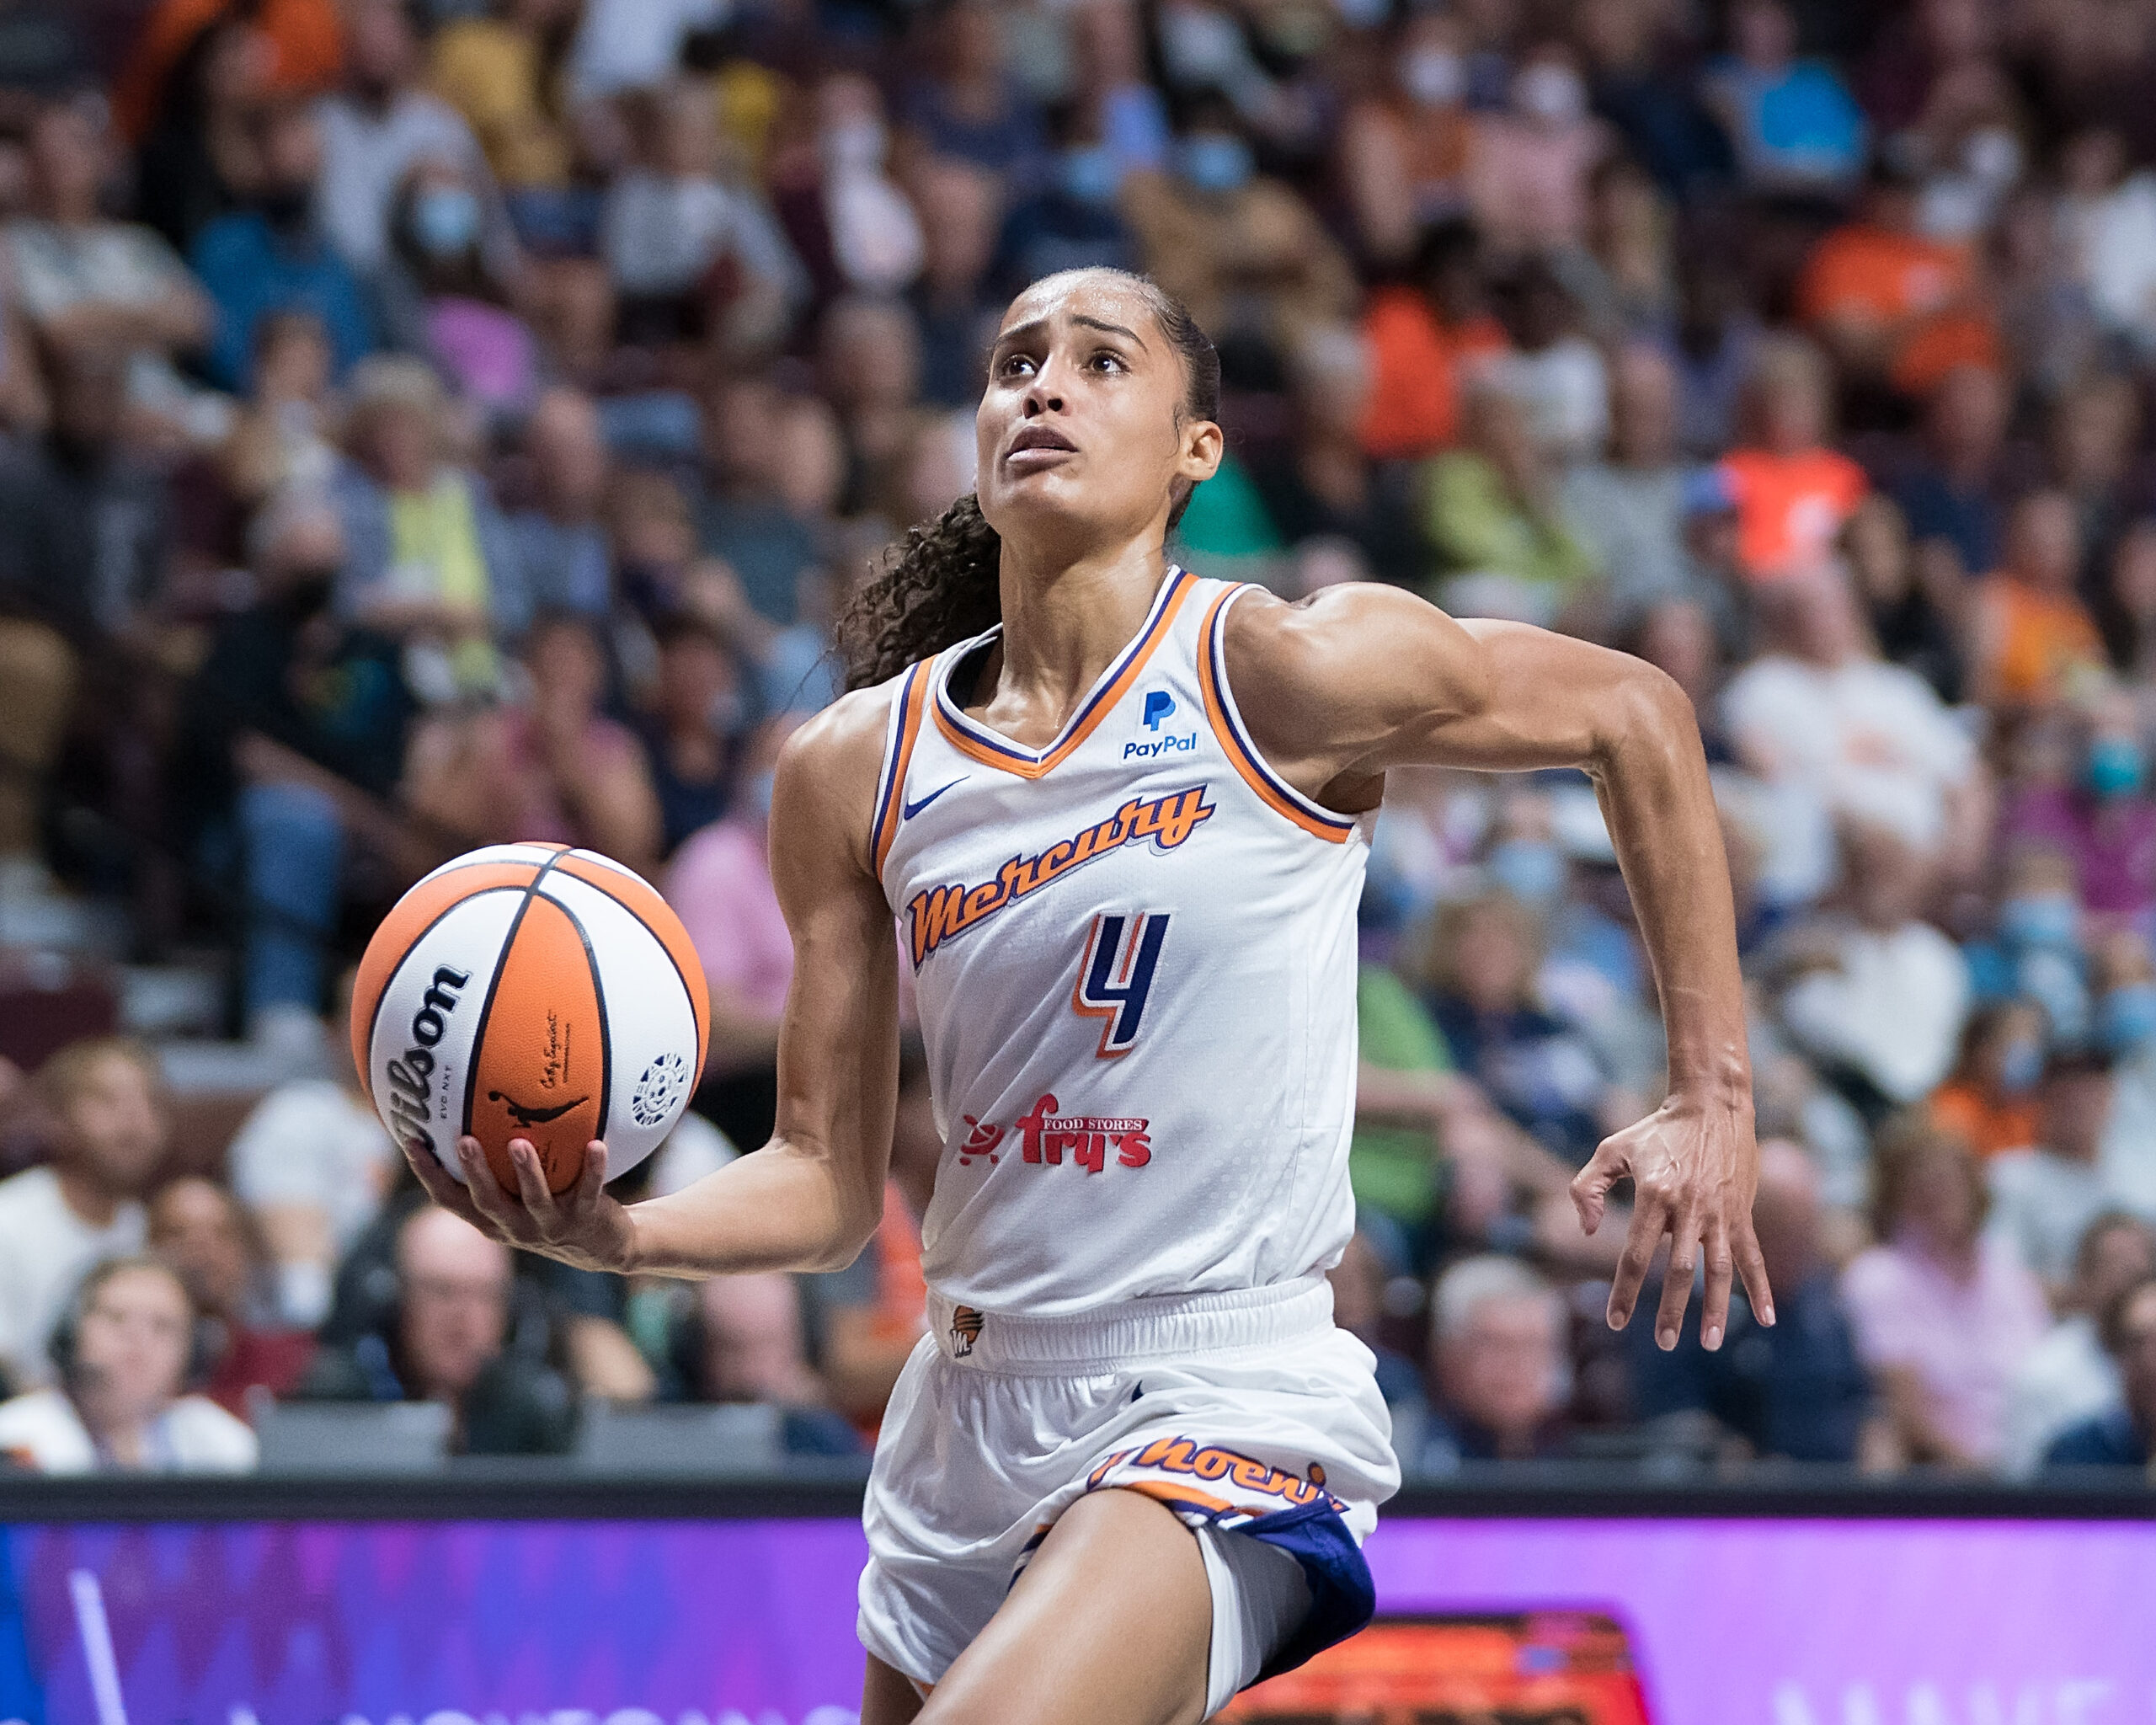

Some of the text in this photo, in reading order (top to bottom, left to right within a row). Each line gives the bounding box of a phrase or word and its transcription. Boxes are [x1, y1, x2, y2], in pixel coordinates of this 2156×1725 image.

[1123, 732, 1198, 760] PayPal
[907, 783, 1217, 972] Mercury
[1072, 910, 1172, 1059] 4
[440, 1065, 452, 1119] EVO NXT
[1043, 1117, 1144, 1131] FOOD STORES
[1015, 1093, 1152, 1173] fry's
